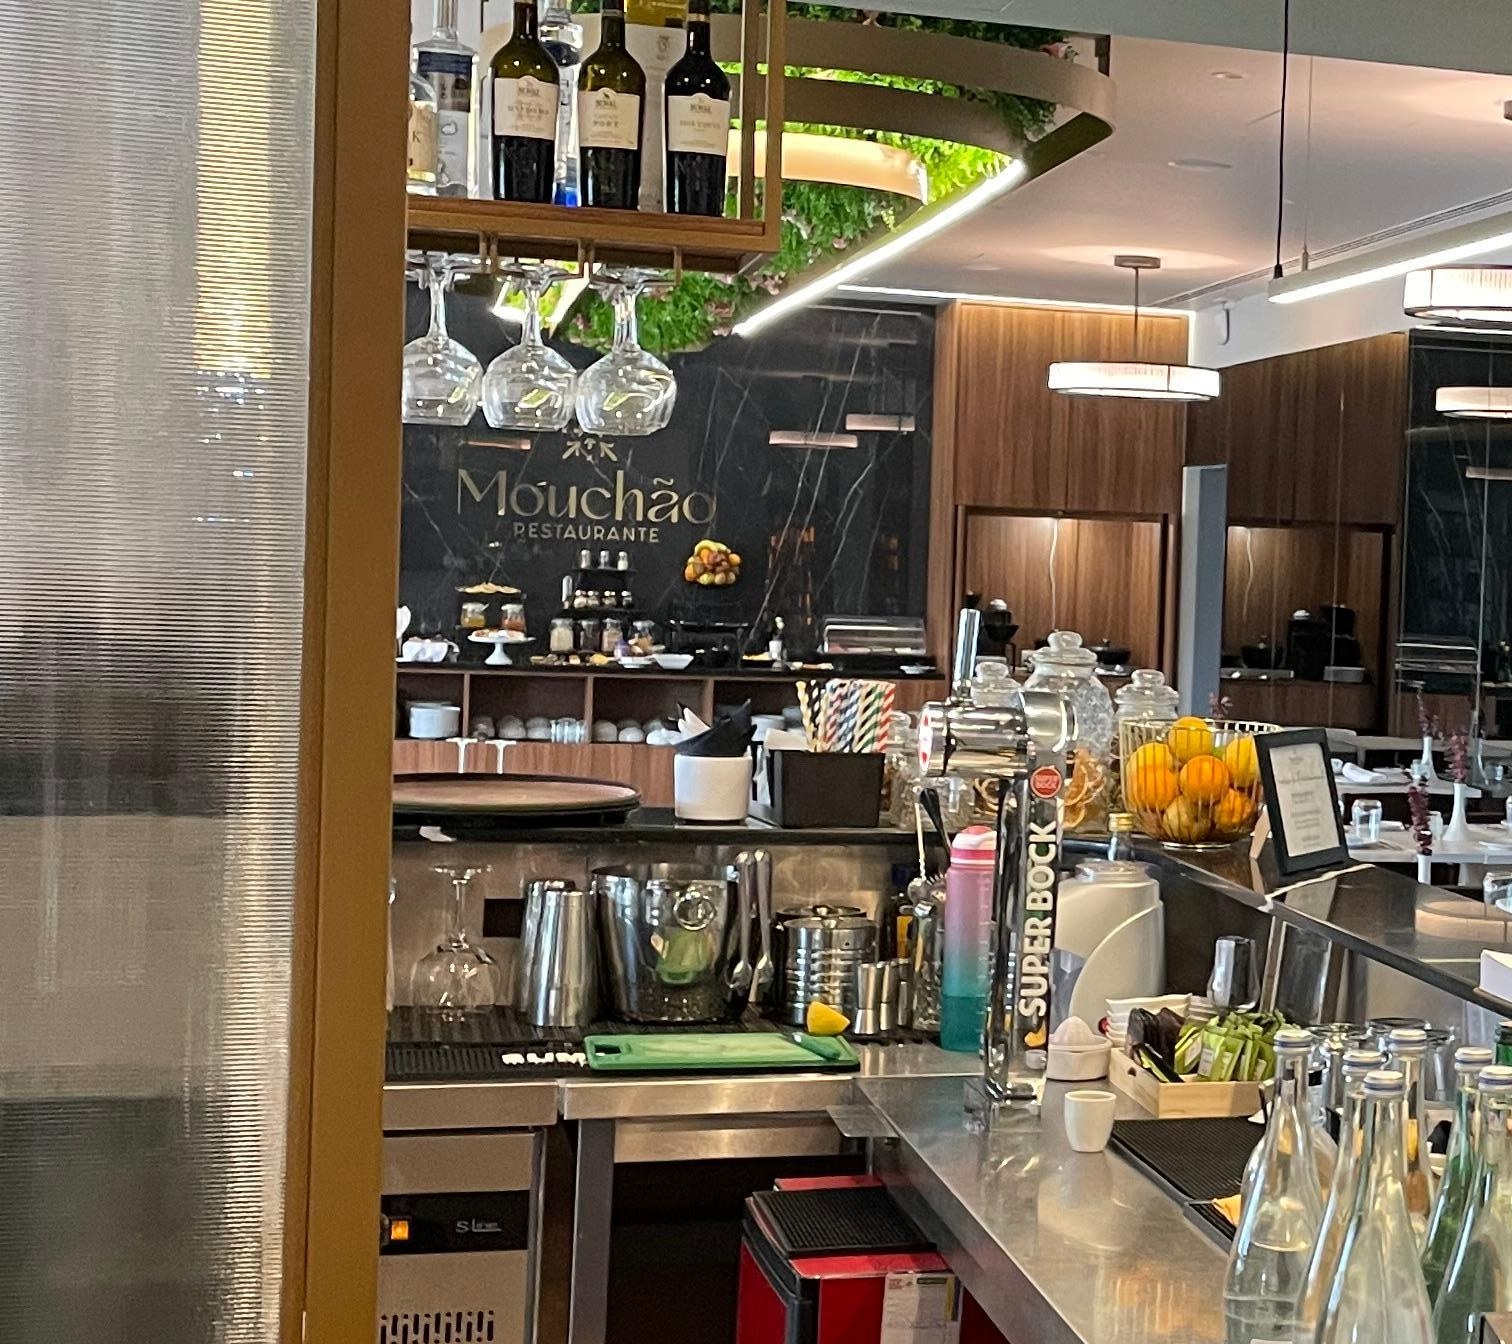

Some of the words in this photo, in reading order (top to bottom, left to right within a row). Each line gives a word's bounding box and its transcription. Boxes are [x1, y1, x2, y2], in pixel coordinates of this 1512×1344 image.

[457, 468, 718, 525] Mouchão
[513, 522, 660, 543] RESTAURANTE
[1026, 820, 1057, 912] BOCK
[1018, 916, 1052, 1017] SUPER
